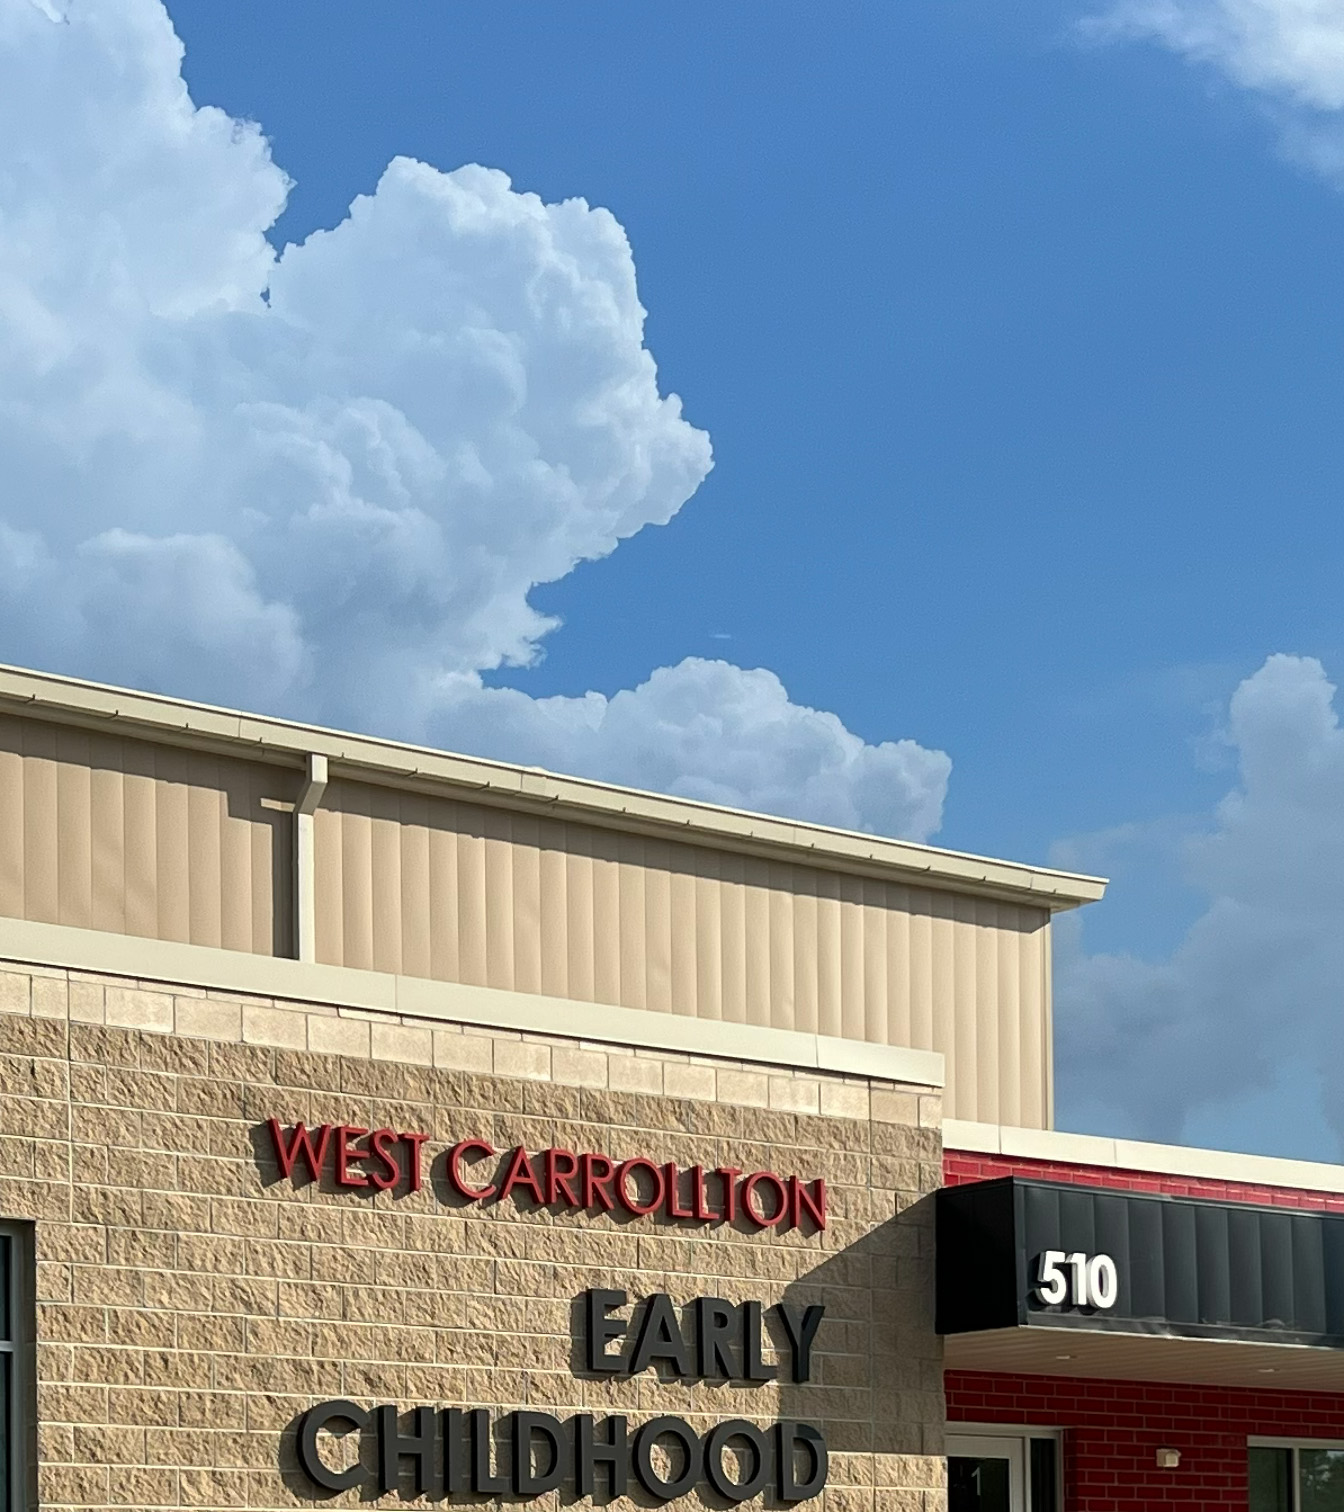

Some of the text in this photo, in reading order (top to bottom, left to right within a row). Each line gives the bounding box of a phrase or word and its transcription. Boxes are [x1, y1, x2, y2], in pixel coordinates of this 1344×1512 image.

[268, 1118, 827, 1231] WEST CARROLLTON
[1036, 1250, 1118, 1309] 510
[585, 1288, 826, 1383] EARLY
[297, 1400, 830, 1501] CHILDHOOD
[971, 1466, 981, 1496] 1
